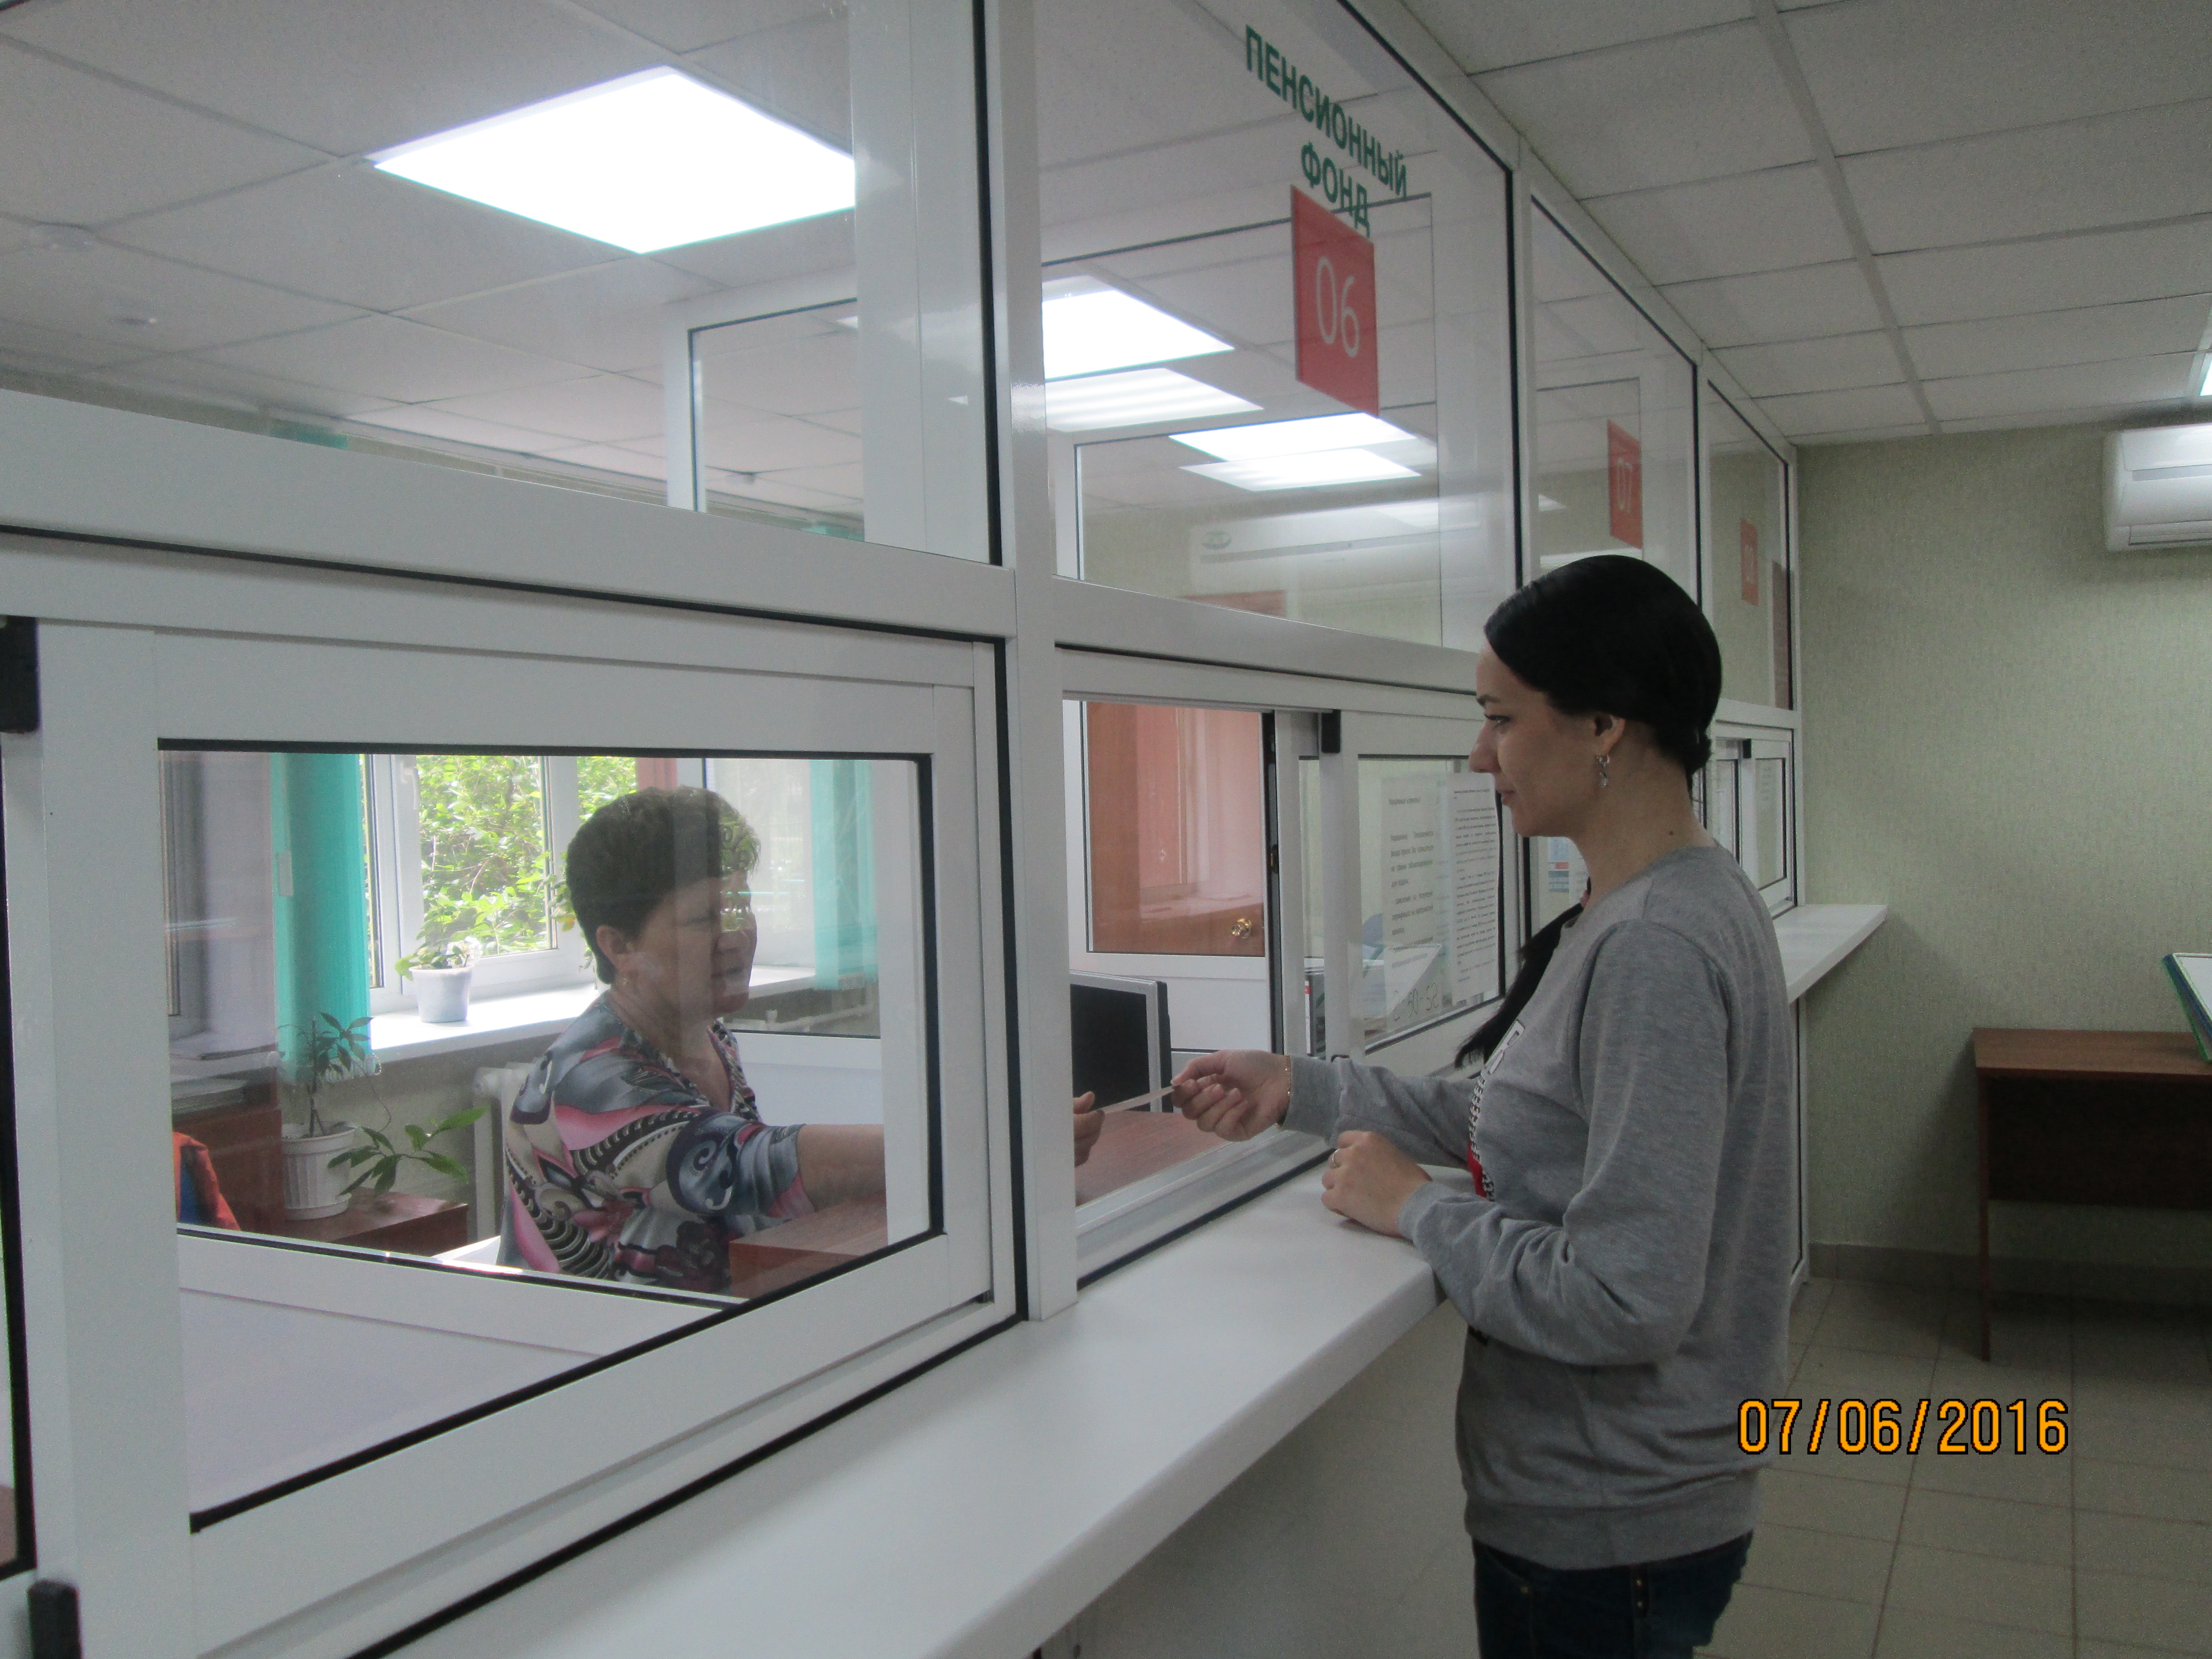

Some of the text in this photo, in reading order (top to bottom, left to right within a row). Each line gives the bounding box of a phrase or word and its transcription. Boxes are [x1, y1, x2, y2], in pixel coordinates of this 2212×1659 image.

[1246, 24, 1407, 198] ПЕНСИОННЫЙ
[1301, 141, 1370, 239] ФОНД
[1316, 255, 1359, 358] 06
